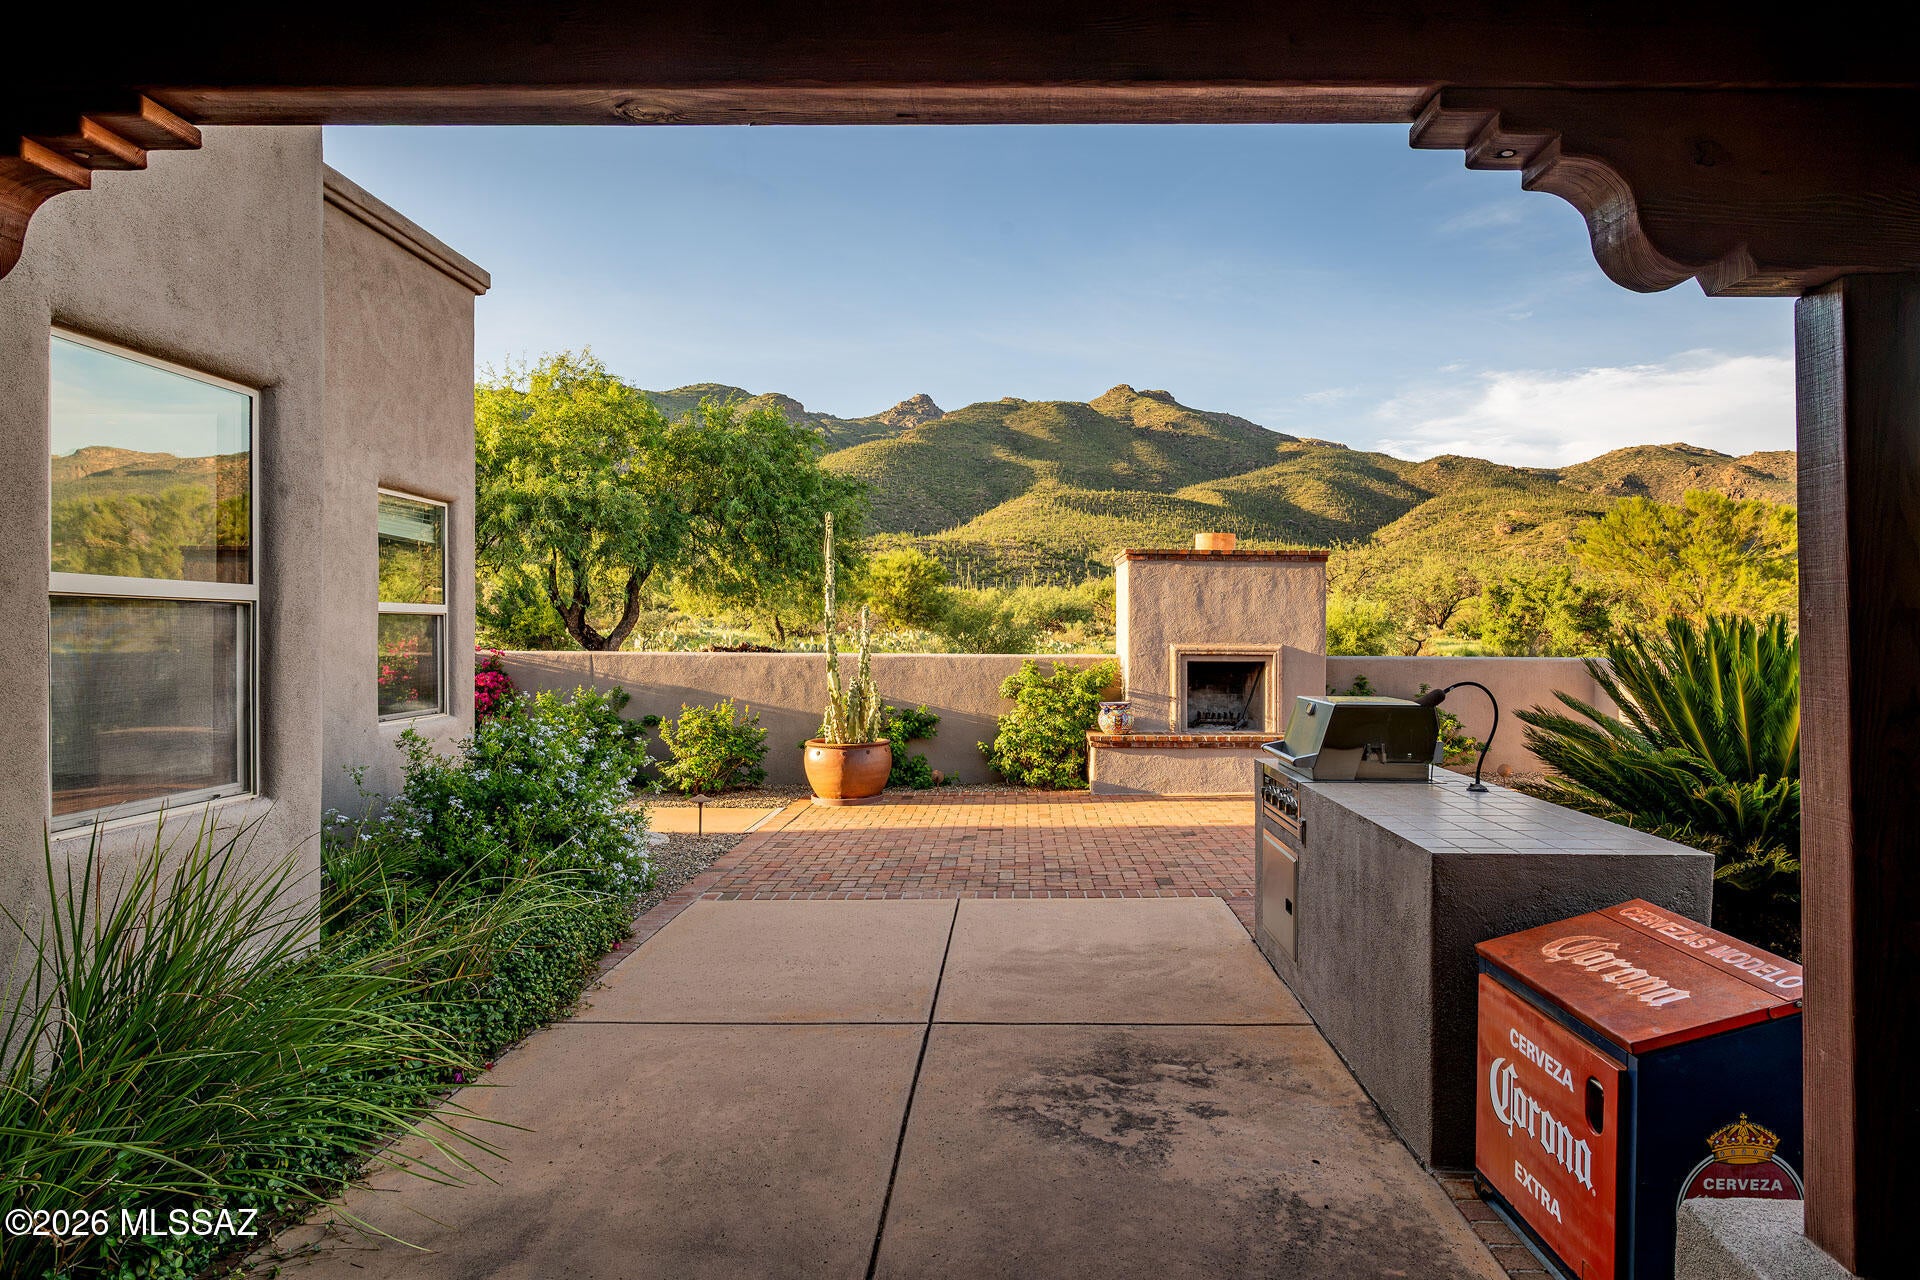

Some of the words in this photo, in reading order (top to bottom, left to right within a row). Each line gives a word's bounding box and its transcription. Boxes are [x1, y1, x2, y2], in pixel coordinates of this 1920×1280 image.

[1541, 935, 1691, 1008] Corona
[1619, 906, 1717, 950] CERVEZAS
[1709, 944, 1802, 989] MODELO
[1509, 1027, 1574, 1093] CERVEZA
[1489, 1057, 1594, 1193] Corona
[1513, 1160, 1562, 1224] EXTRA
[1702, 1177, 1783, 1192] CERVEZA
